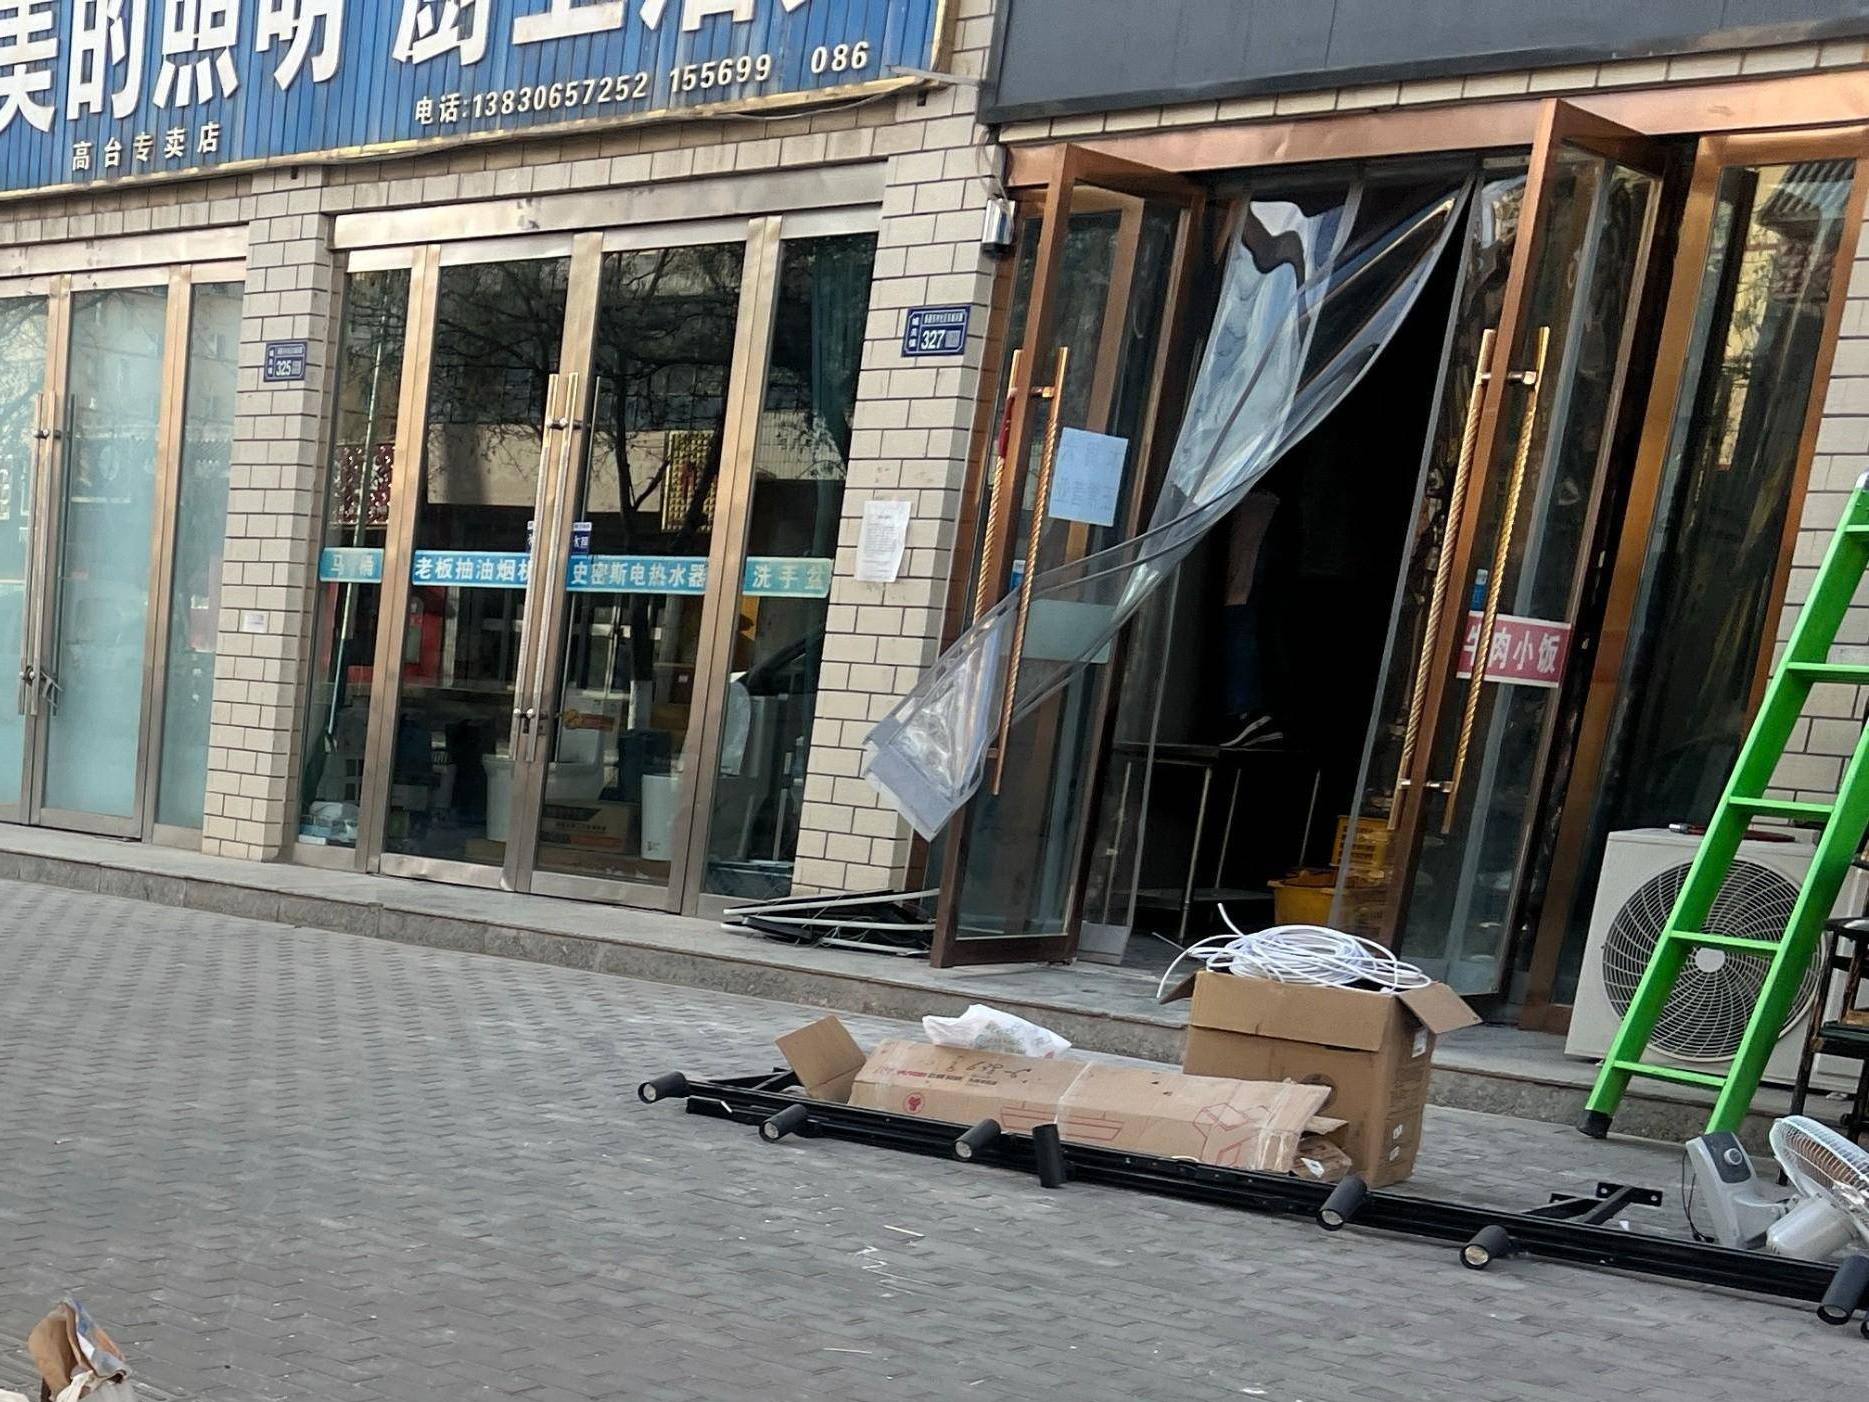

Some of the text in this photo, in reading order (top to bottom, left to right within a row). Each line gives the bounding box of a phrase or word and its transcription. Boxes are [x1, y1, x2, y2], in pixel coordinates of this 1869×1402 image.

[414, 40, 870, 124] 电话:13830657252 155699 086
[71, 121, 222, 171] 高台专卖店
[920, 330, 946, 349] 327
[275, 360, 292, 376] 325
[571, 560, 706, 588] 史密斯电热水器
[752, 564, 824, 590] 洗手盆
